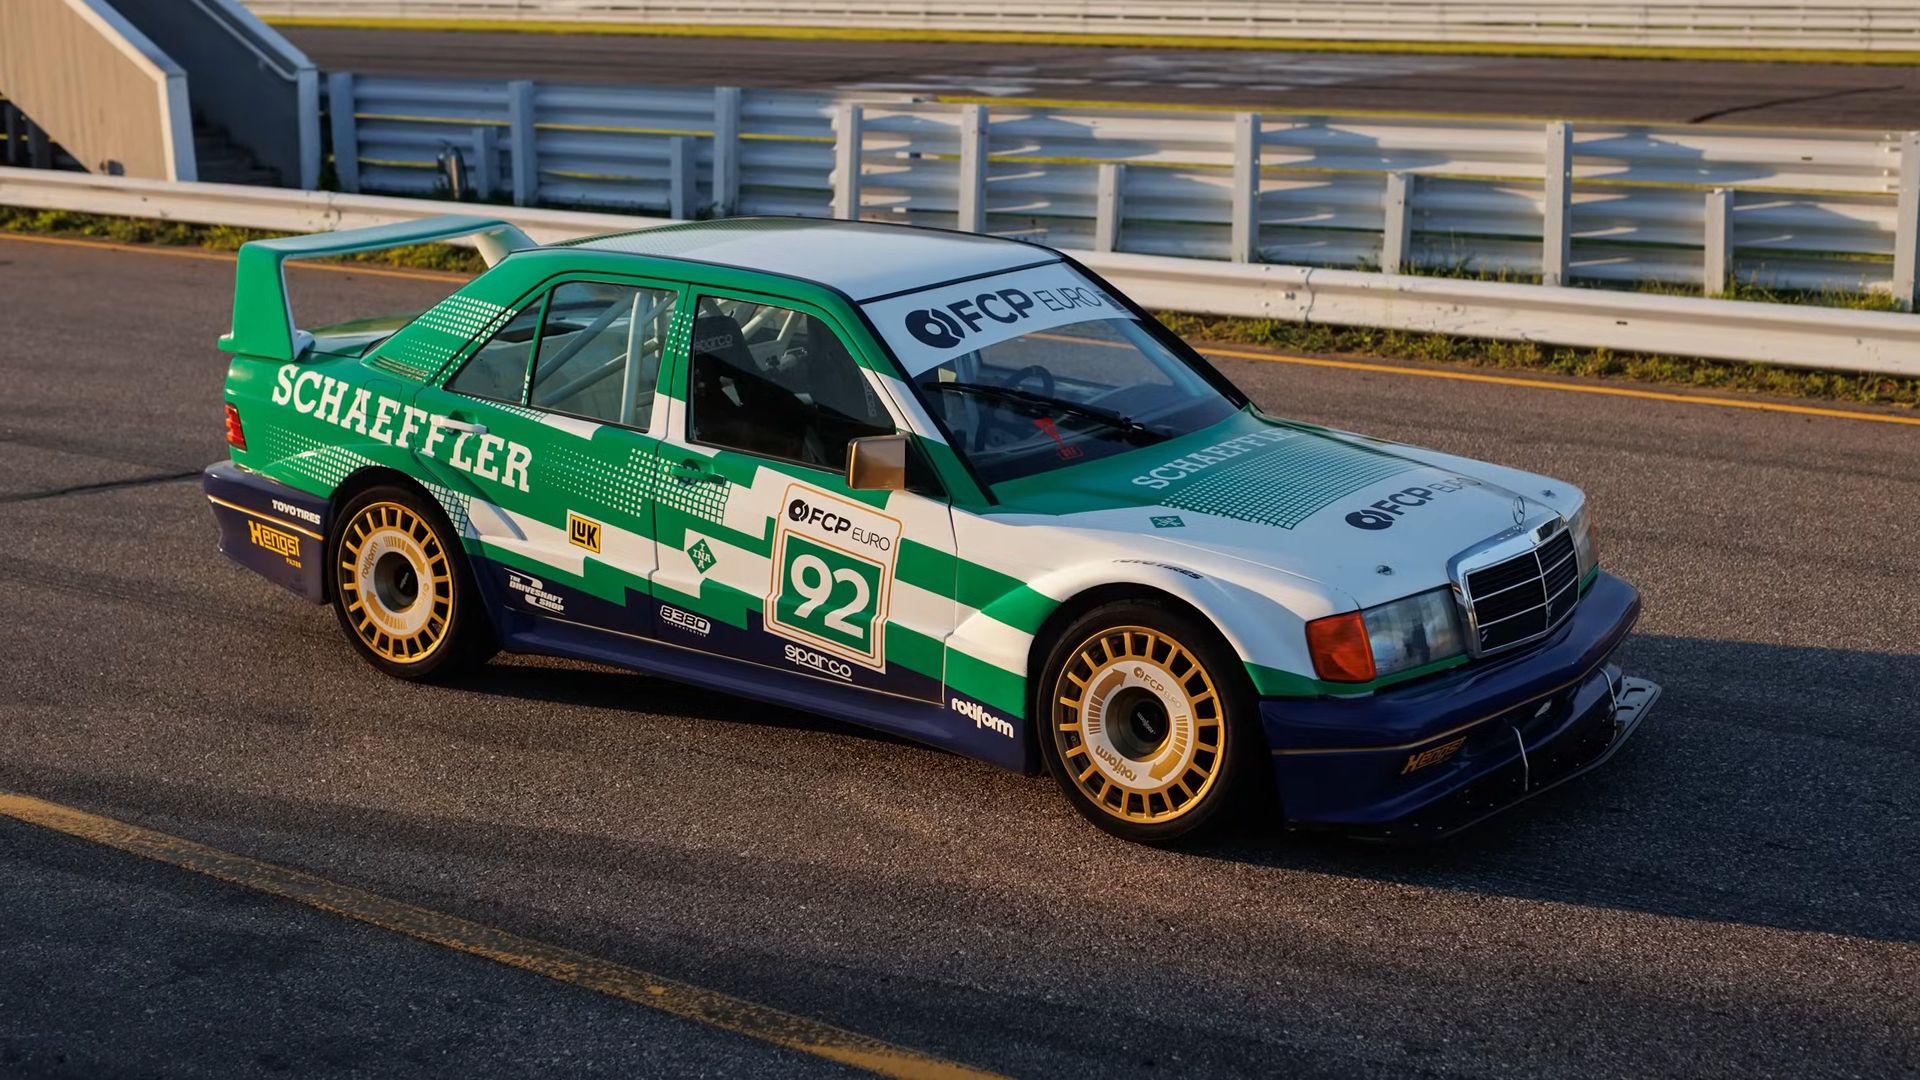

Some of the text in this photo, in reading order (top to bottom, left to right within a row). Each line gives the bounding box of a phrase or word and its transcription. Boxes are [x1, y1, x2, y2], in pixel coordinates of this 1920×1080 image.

[946, 286, 1102, 333] FCP EURO
[272, 364, 532, 492] SCHAEFFLER
[1369, 487, 1434, 515] FCP
[248, 520, 300, 557] Hengst
[808, 508, 890, 551] FCP EURO
[509, 580, 563, 604] DRIVESHAFT
[539, 598, 565, 611] SHOP
[791, 554, 870, 639] 92
[660, 605, 710, 633] 8380
[785, 644, 852, 678] sparco
[1143, 675, 1165, 692] FCP
[951, 696, 1014, 739] rotiform
[1095, 745, 1137, 782] rotiform
